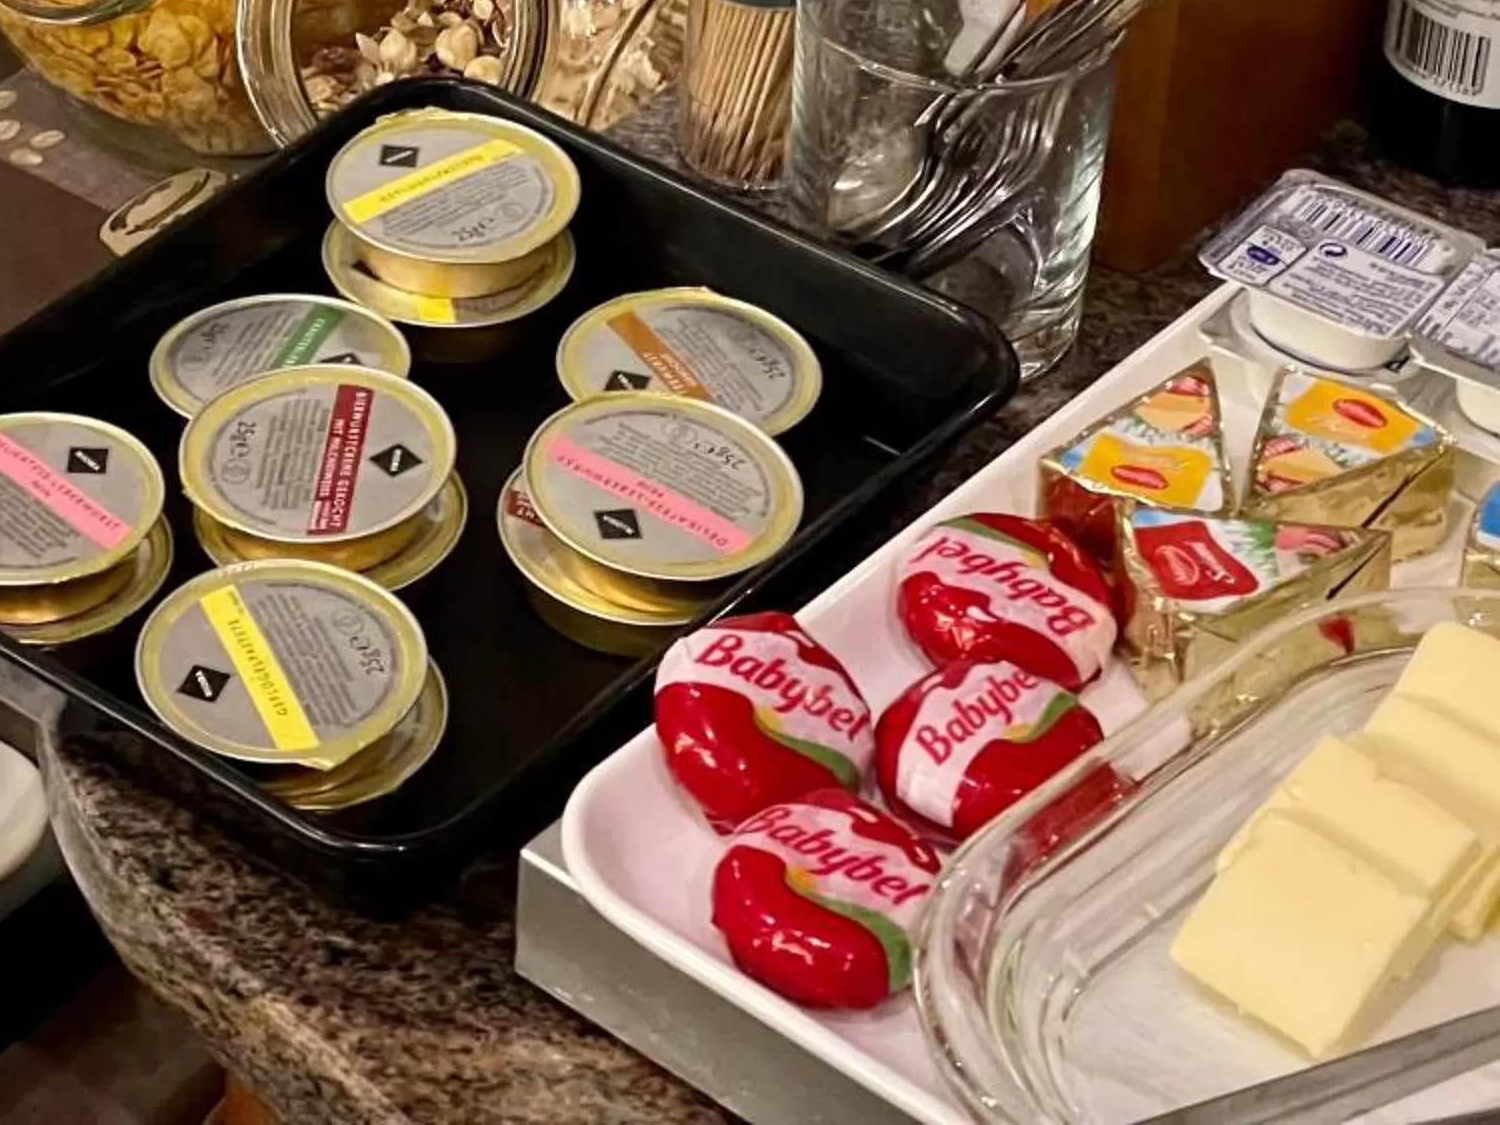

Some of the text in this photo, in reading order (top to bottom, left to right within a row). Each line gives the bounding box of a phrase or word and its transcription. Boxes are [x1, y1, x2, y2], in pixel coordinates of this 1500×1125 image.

[909, 537, 1097, 636] Babybel
[695, 634, 871, 741] Babybel
[916, 673, 1039, 765] Babybe
[743, 807, 931, 905] Babybel
